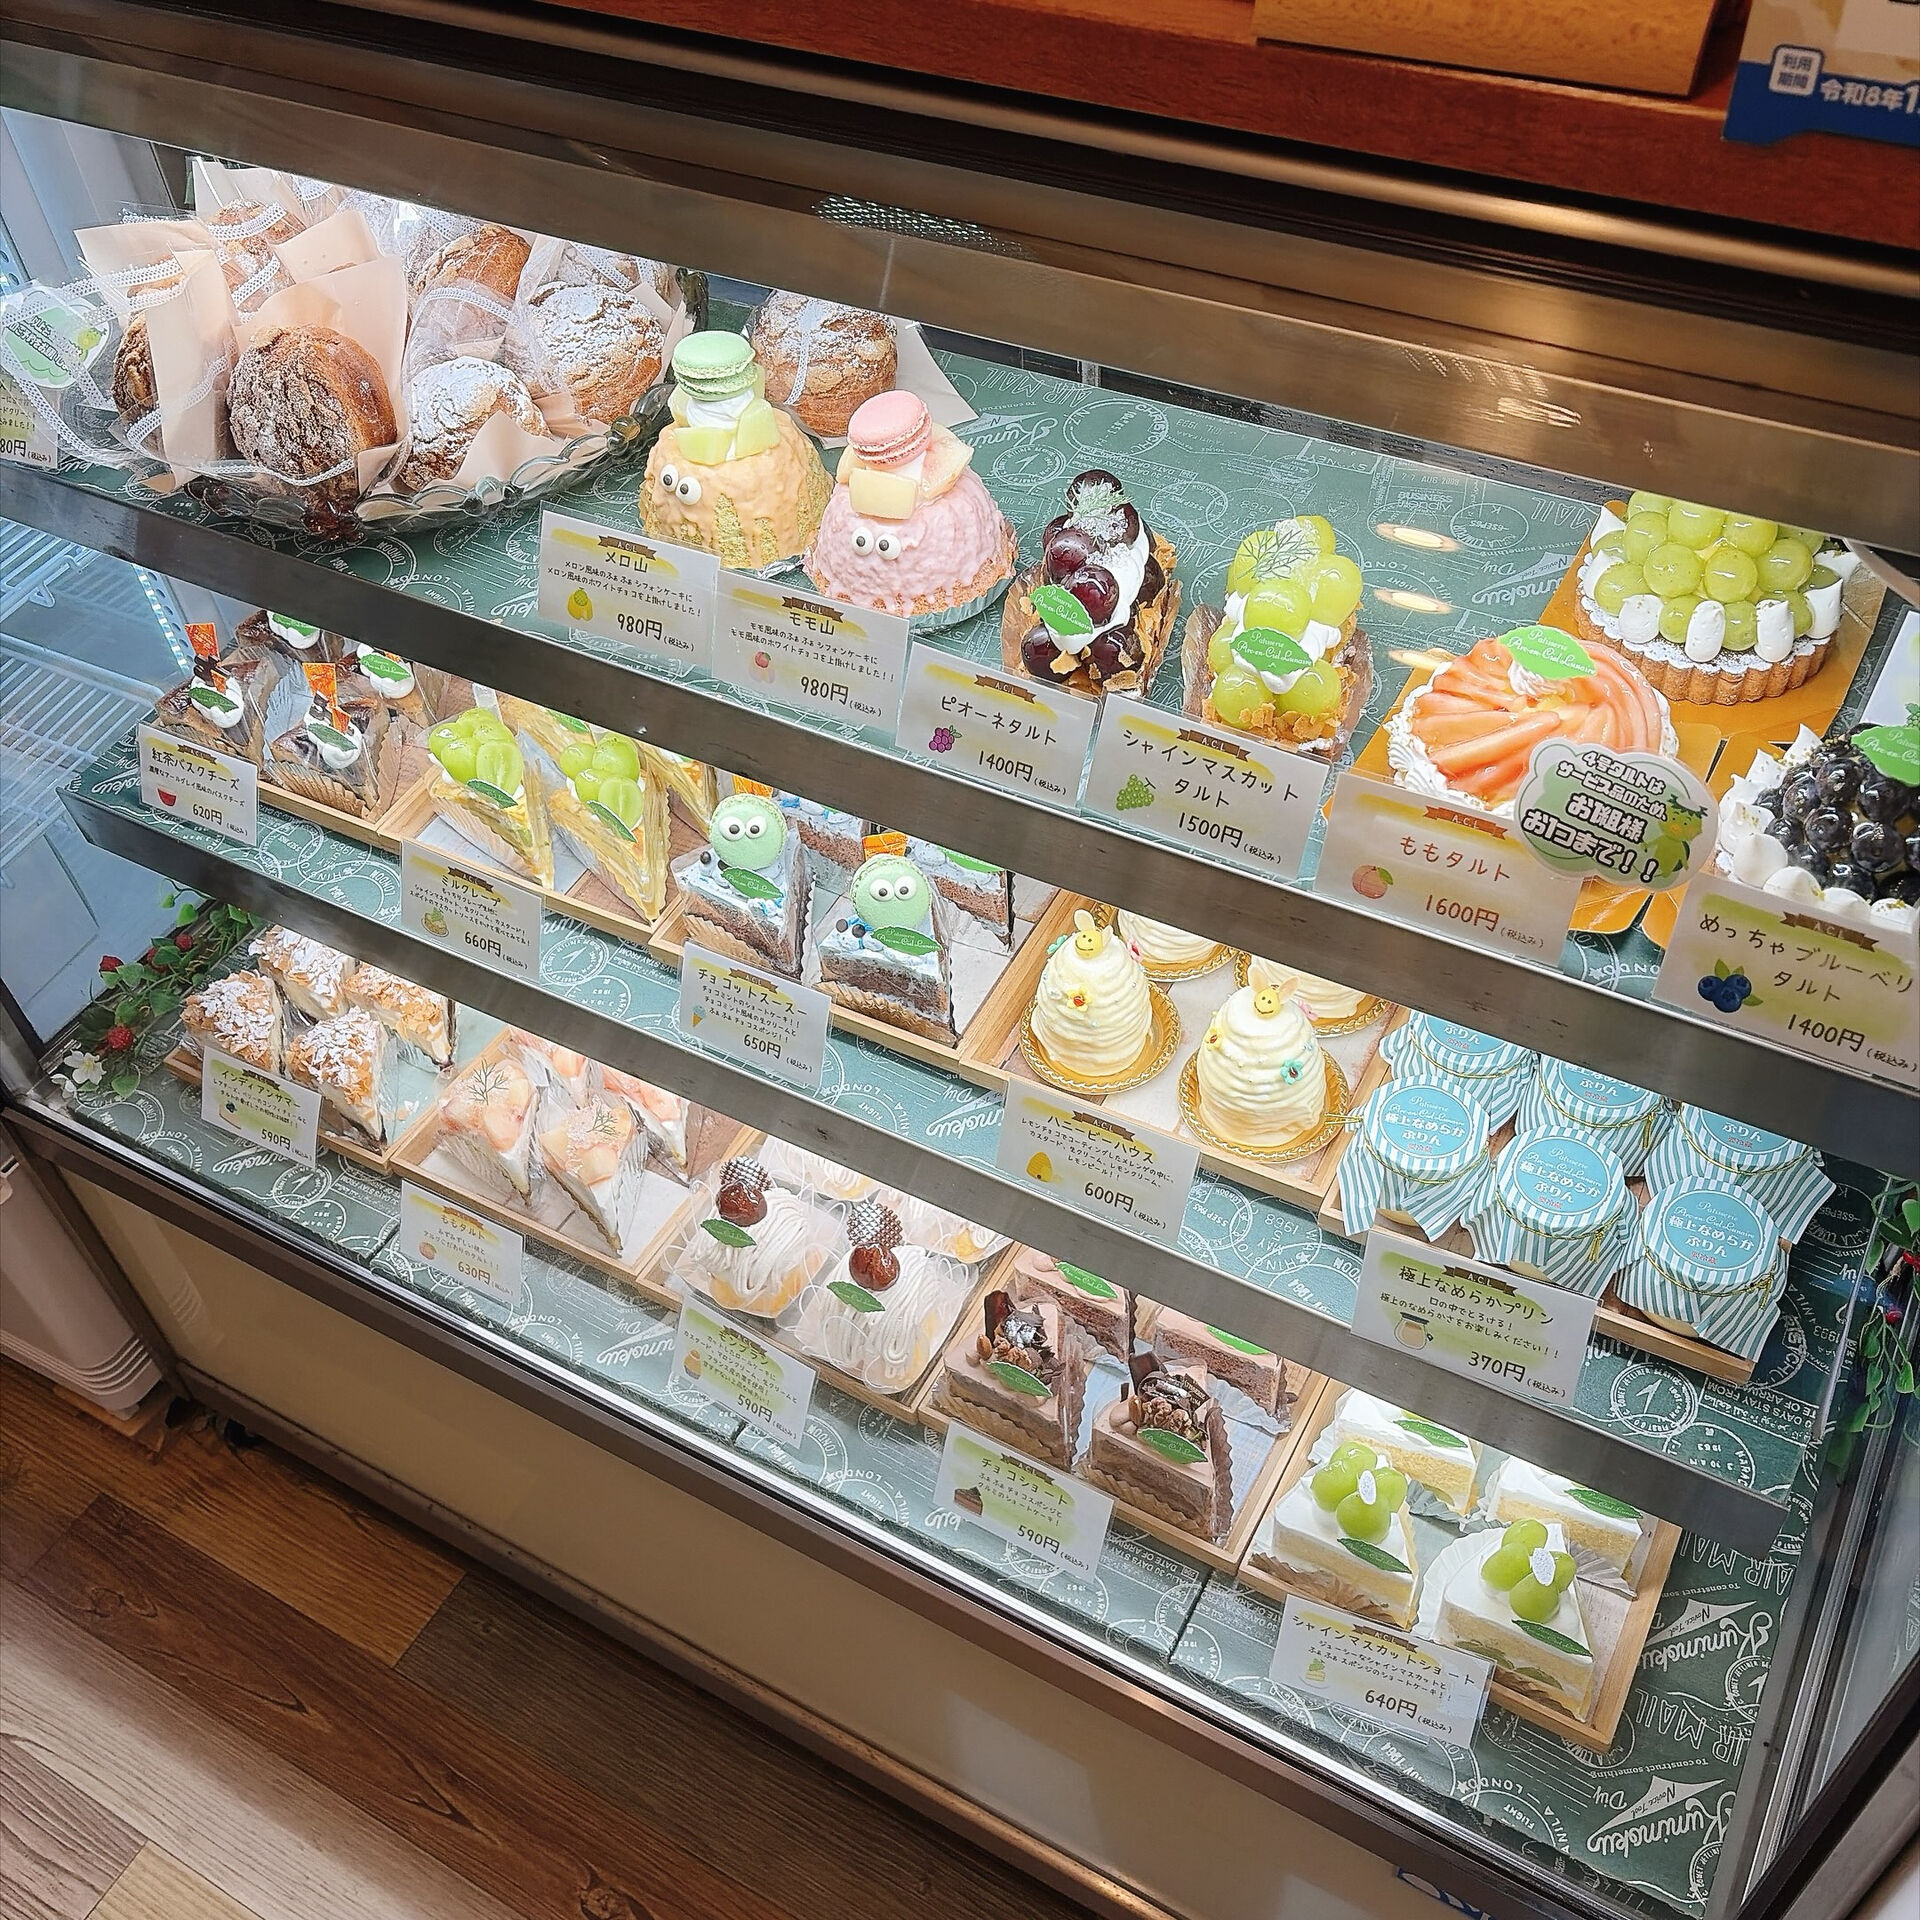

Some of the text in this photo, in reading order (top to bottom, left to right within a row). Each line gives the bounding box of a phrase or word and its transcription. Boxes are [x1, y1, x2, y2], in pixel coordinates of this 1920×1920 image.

[1781, 53, 1812, 72] 利用
[1776, 71, 1808, 89] 期間
[605, 552, 648, 573] メロ山
[617, 541, 637, 552] A.C.L
[789, 612, 835, 635] モモ山
[802, 603, 823, 615] A.C.L
[617, 613, 695, 652] 980円 （税込み）
[801, 676, 882, 717] 980円 （税込み）
[994, 680, 1017, 695] A.C.L
[940, 695, 1058, 746] ピオーネタルト
[1201, 736, 1226, 752] A.C.L
[152, 748, 240, 790] 紅茶バスクチーズ
[978, 750, 1067, 796] 1400円 （税込み）
[1123, 729, 1299, 802] シャインマスカット
[1582, 751, 1665, 795] 4号タルトは
[1174, 777, 1231, 809] タルト
[1556, 761, 1667, 821] サービス品のため、
[193, 803, 222, 825] 620円
[1179, 811, 1281, 864] 1500円 （税込み）
[1398, 834, 1512, 884] ももタルト
[442, 875, 501, 907] ミルクレープ
[1424, 893, 1545, 949] 1600円 （税込み）
[464, 932, 501, 957] 660円
[1700, 914, 1913, 993] めっちゃブルーベリ
[698, 968, 807, 1016] チョコットスースー
[1773, 971, 1840, 1002] タルト
[744, 1034, 781, 1059] 650円
[1443, 1025, 1481, 1046] ぷりん
[1788, 1014, 1918, 1073] 1400円 （税込み）
[222, 1070, 301, 1108] インディアンサマー
[942, 1084, 973, 1103] Diy
[1580, 1078, 1619, 1097] ぷりん
[261, 1129, 290, 1150] 590円
[1048, 1115, 1154, 1164] ハニービーハウス
[1093, 1119, 1113, 1131] A.C.L
[1402, 1130, 1440, 1146] ぷりん
[1723, 1122, 1763, 1143] ぷりん
[1520, 1161, 1600, 1198] 極上なめらか
[1534, 1181, 1574, 1203] ぷりん
[1085, 1182, 1166, 1229] 600円 （税込み）
[441, 1215, 485, 1241] ももタルト
[1669, 1216, 1754, 1250] 極上なめらか
[1685, 1235, 1727, 1257] ぷりん
[458, 1261, 490, 1285] 630円
[1467, 1273, 1493, 1287] A.C.L
[1398, 1265, 1554, 1325] 極上なめらかプリン
[1380, 1292, 1559, 1359] 極上のなめらかさをお楽しみください！！
[1429, 1297, 1513, 1331] 口の中でとろける！
[719, 1330, 768, 1365] モンブラン
[1468, 1351, 1566, 1398] 370円 （税込み）
[738, 1394, 772, 1423] 590円
[1706, 1381, 1803, 1426] DAYS STAY FROM
[982, 1458, 1068, 1506] チョコショート
[1018, 1525, 1060, 1554] 590円
[1155, 1556, 1178, 1572] DATE
[1744, 1556, 1795, 1595] AIR
[1374, 1631, 1396, 1643] A.C.L
[1668, 1605, 1710, 1638] Novice Tool
[1292, 1615, 1475, 1686] シャインマスカットショート
[1365, 1689, 1453, 1734] 640円 （税込み）
[1635, 1687, 1706, 1749] MAIL
[1590, 1758, 1709, 1779] To construct something
[1593, 1785, 1627, 1810] Diy
[1630, 1783, 1676, 1820] Novice Tool
[1504, 1803, 1536, 1831] FLIGHT
